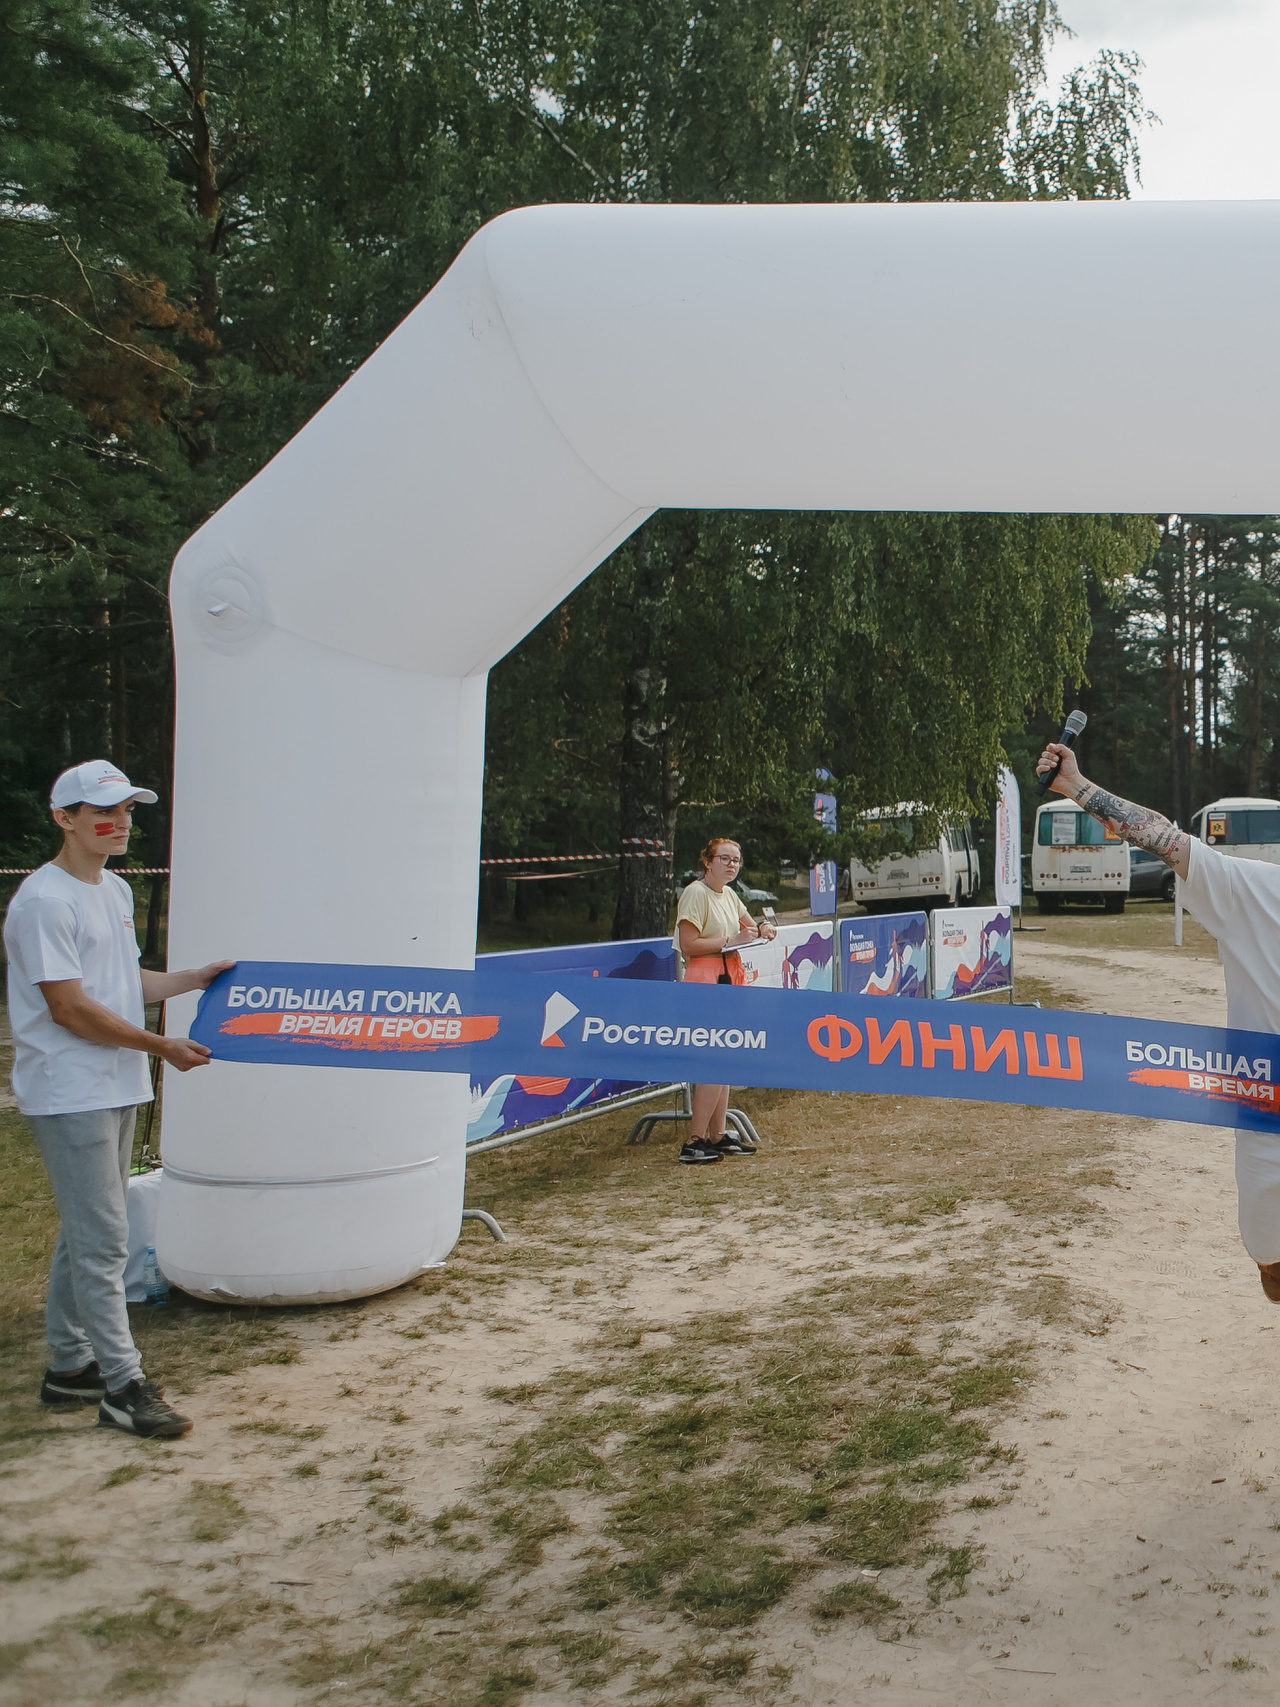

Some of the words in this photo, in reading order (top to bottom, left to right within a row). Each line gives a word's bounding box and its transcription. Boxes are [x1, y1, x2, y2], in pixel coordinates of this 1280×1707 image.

[228, 986, 365, 1011] БОЛЬШАЯ
[370, 990, 462, 1014] ГОНКА
[278, 1015, 364, 1036] ВРЕМЯ
[367, 1017, 463, 1040] ГЕРОЕВ
[581, 1016, 767, 1049] Ростелеком
[807, 1015, 1083, 1081] ФИНИШ
[1126, 1040, 1271, 1081] БОЛЬШАЯ
[1188, 1073, 1274, 1101] ВРЕМЯ
